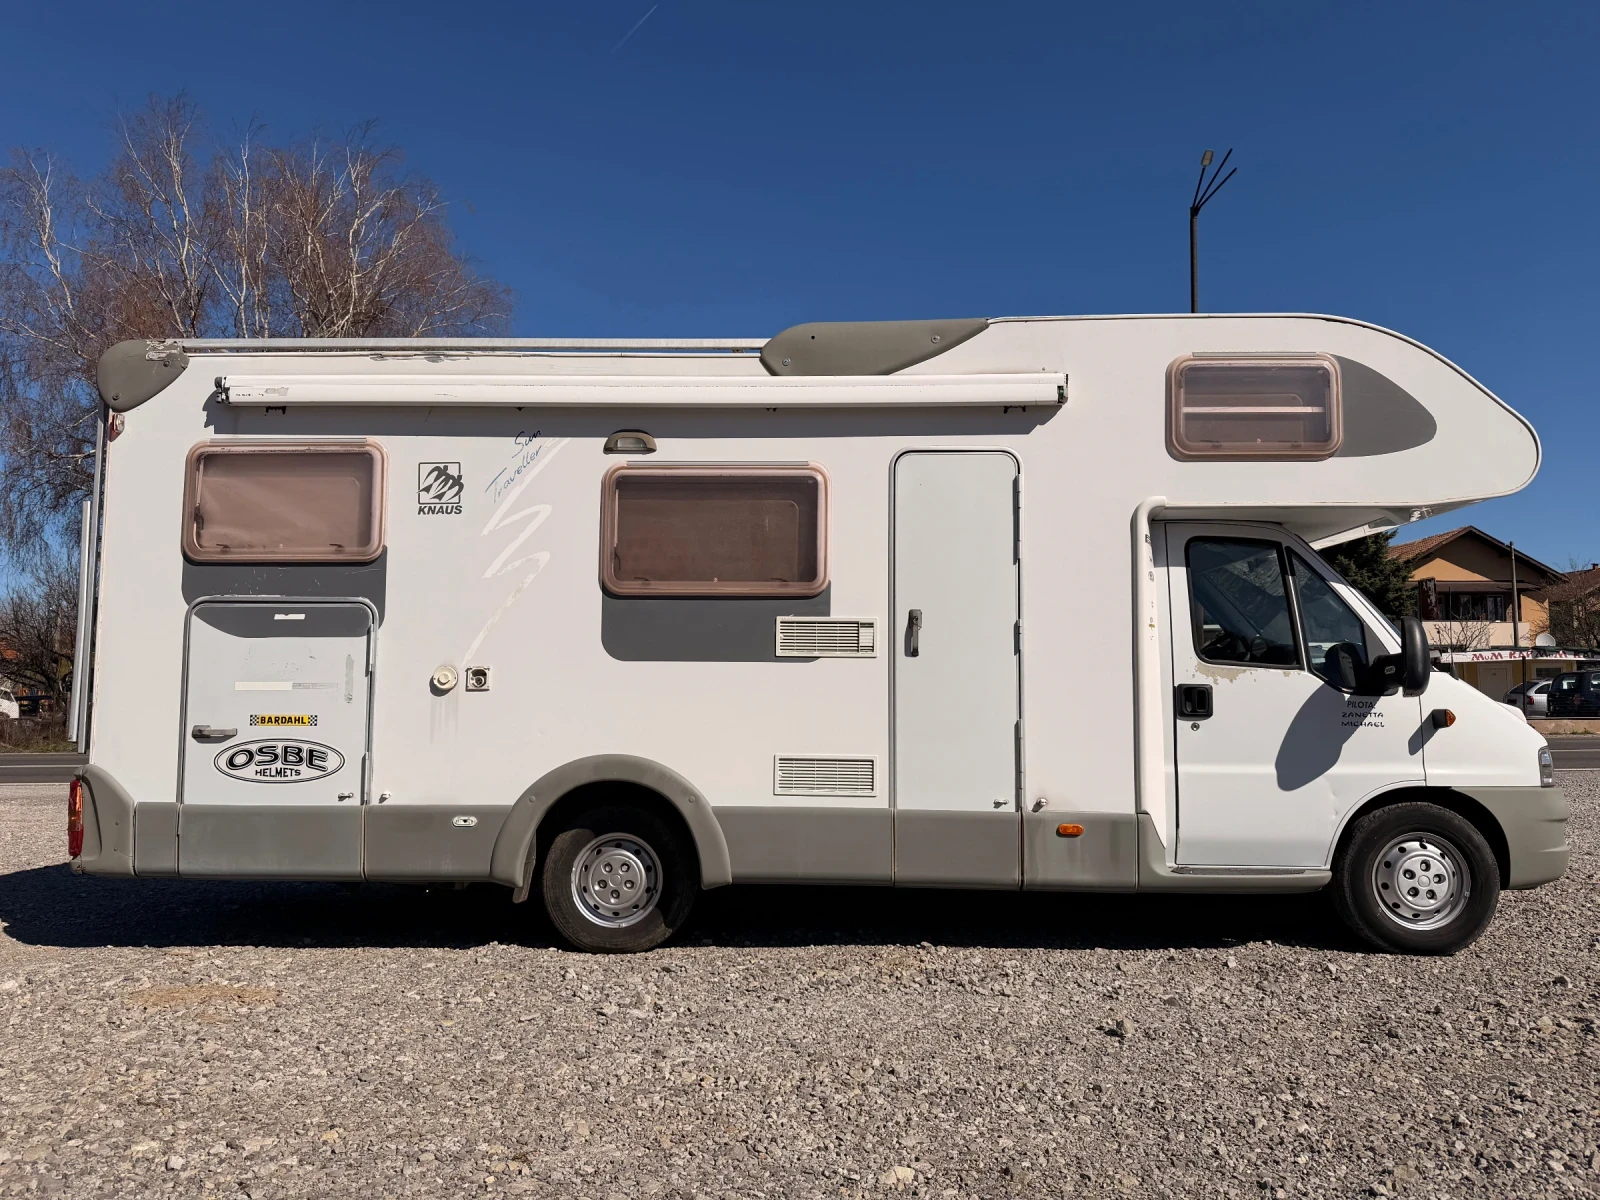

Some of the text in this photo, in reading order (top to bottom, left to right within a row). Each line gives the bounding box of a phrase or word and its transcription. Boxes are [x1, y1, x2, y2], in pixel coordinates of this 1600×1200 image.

[511, 430, 542, 459] Sun
[485, 445, 542, 504] Traveller
[417, 505, 463, 515] KNAUS
[260, 716, 307, 725] BARDAHL
[226, 744, 329, 772] OSBE
[255, 767, 301, 778] HELMETS
